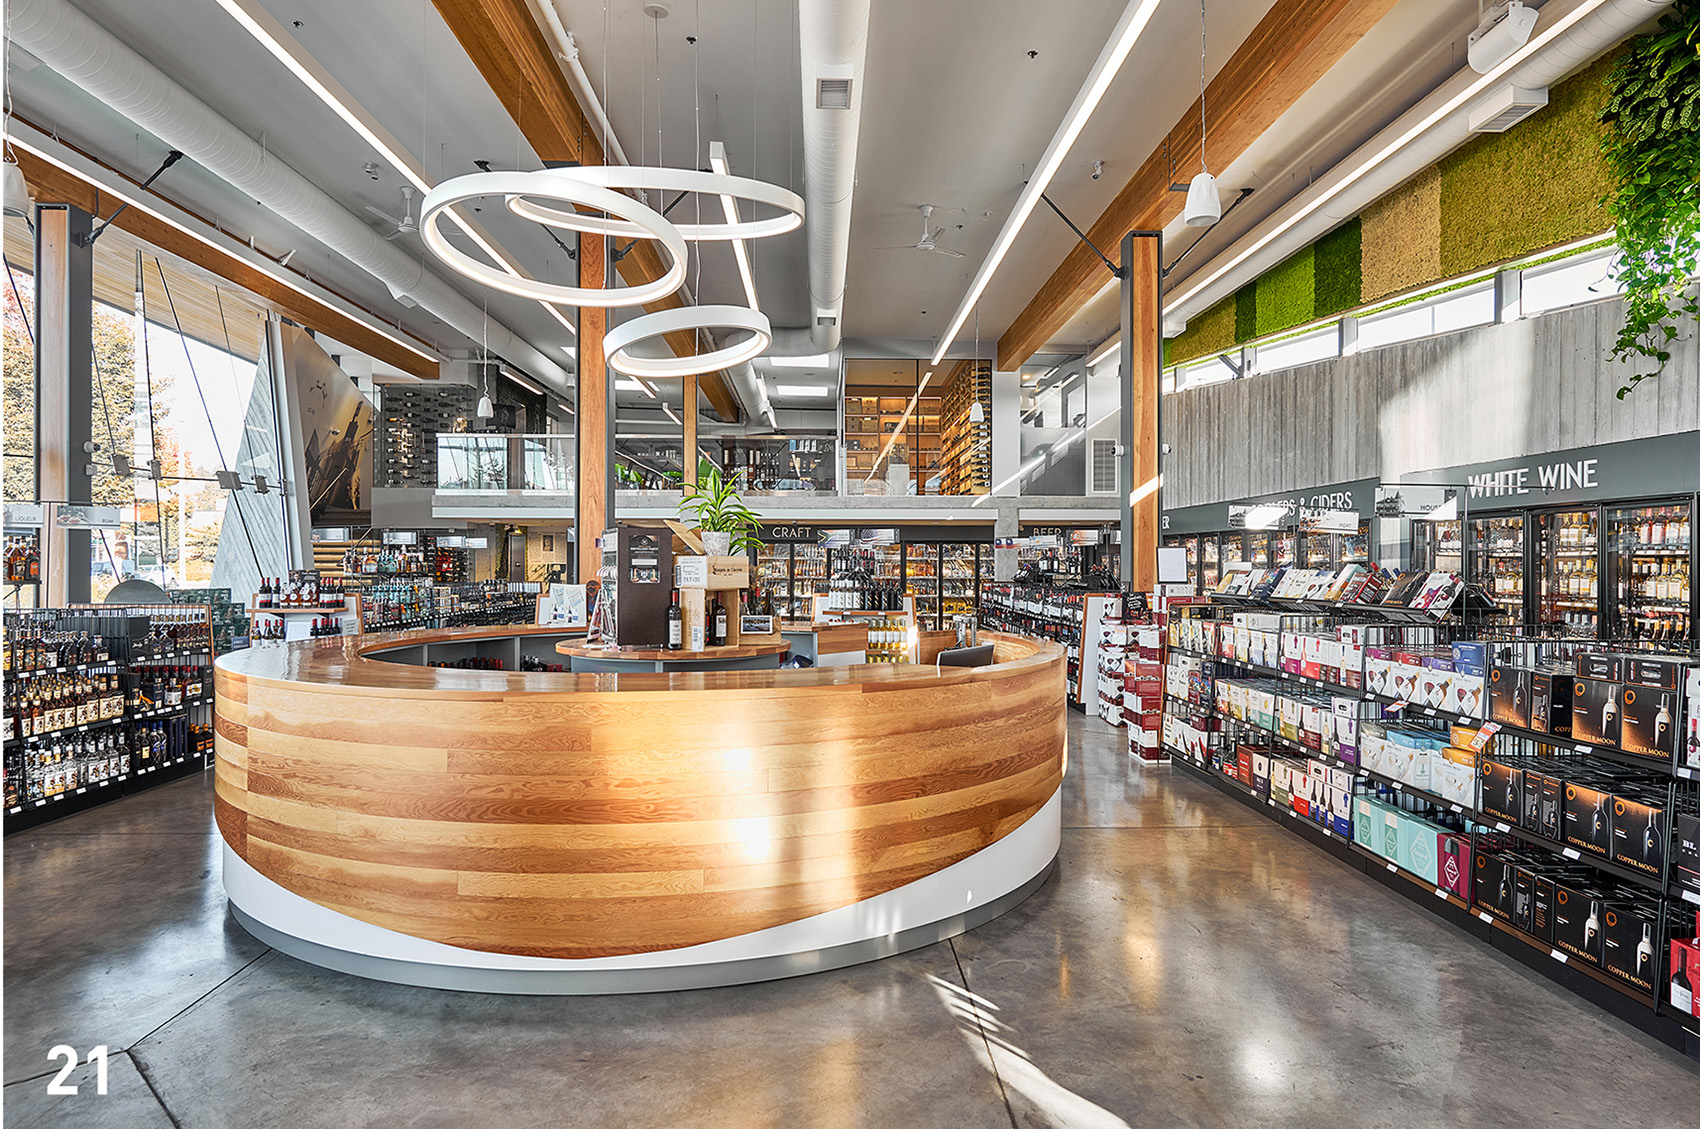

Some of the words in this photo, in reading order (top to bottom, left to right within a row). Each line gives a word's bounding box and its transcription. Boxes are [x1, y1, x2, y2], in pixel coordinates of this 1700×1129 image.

[1467, 468, 1530, 499] WHITE
[1538, 459, 1599, 491] WINE
[1310, 491, 1353, 511] CIDERS
[771, 526, 812, 538] CRAFT
[1574, 731, 1595, 743] COPPER
[1596, 735, 1617, 746] MOON
[1624, 742, 1647, 754] COPPER
[1648, 747, 1670, 758] MOON
[1501, 812, 1518, 823] MOON
[1567, 835, 1587, 847] COPPER
[1586, 841, 1606, 854] MOON
[1616, 853, 1638, 866] COPPER
[1638, 860, 1659, 874] MOON
[1557, 939, 1579, 955] COPPER
[1578, 949, 1598, 963] MOON
[1607, 964, 1630, 980] COPPER
[1630, 975, 1652, 990] MOON
